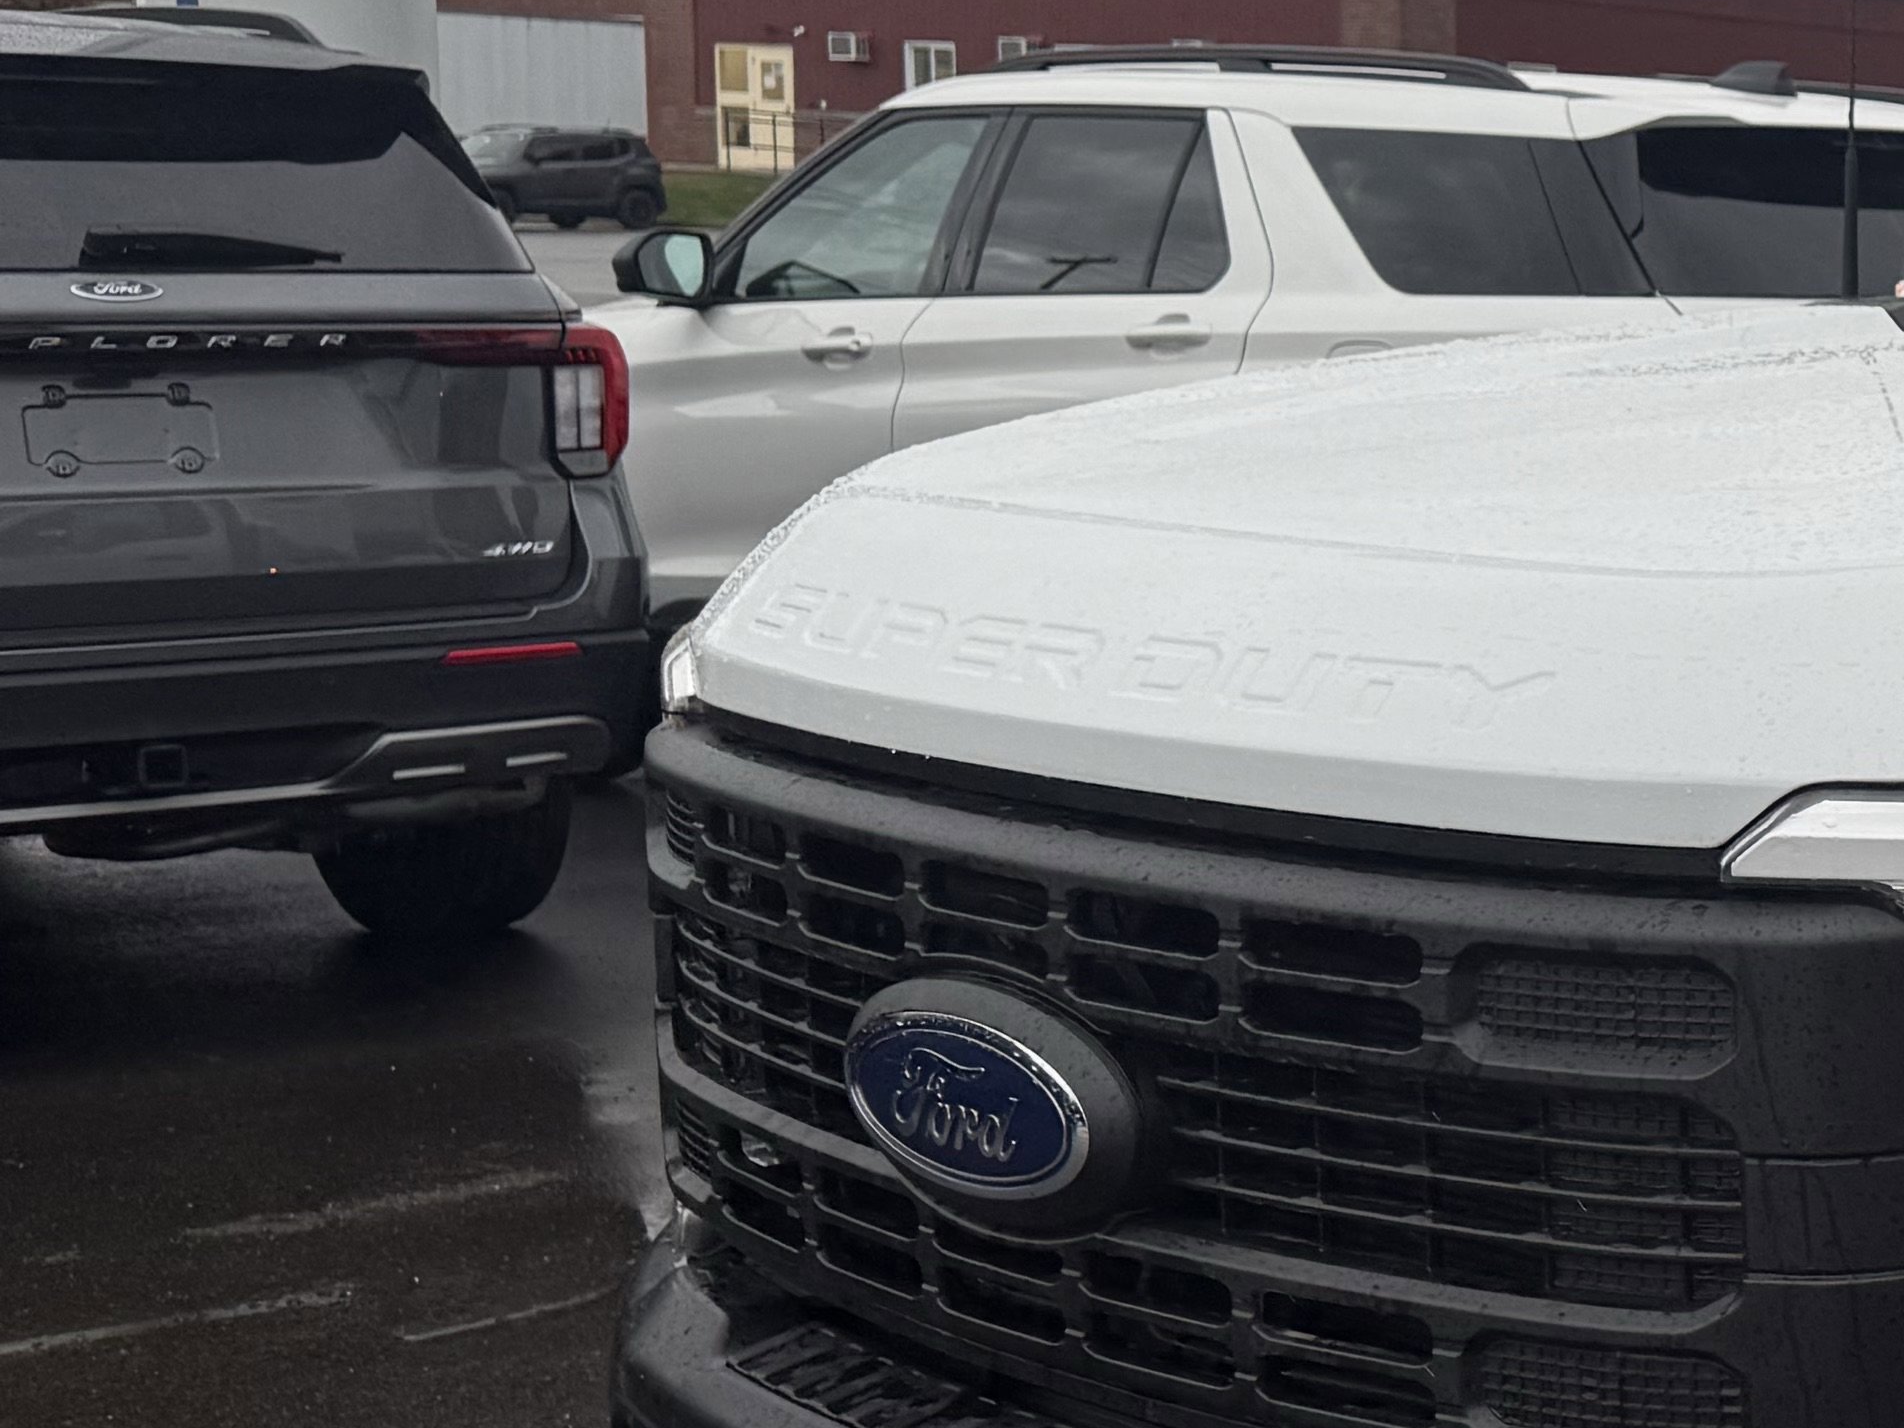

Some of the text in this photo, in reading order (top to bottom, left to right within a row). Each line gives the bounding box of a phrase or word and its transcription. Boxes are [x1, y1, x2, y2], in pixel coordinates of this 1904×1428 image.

[93, 281, 142, 295] Ford
[28, 334, 347, 349] PLORER
[750, 582, 1558, 732] SUPER DUTY
[892, 1047, 1020, 1162] Ford
